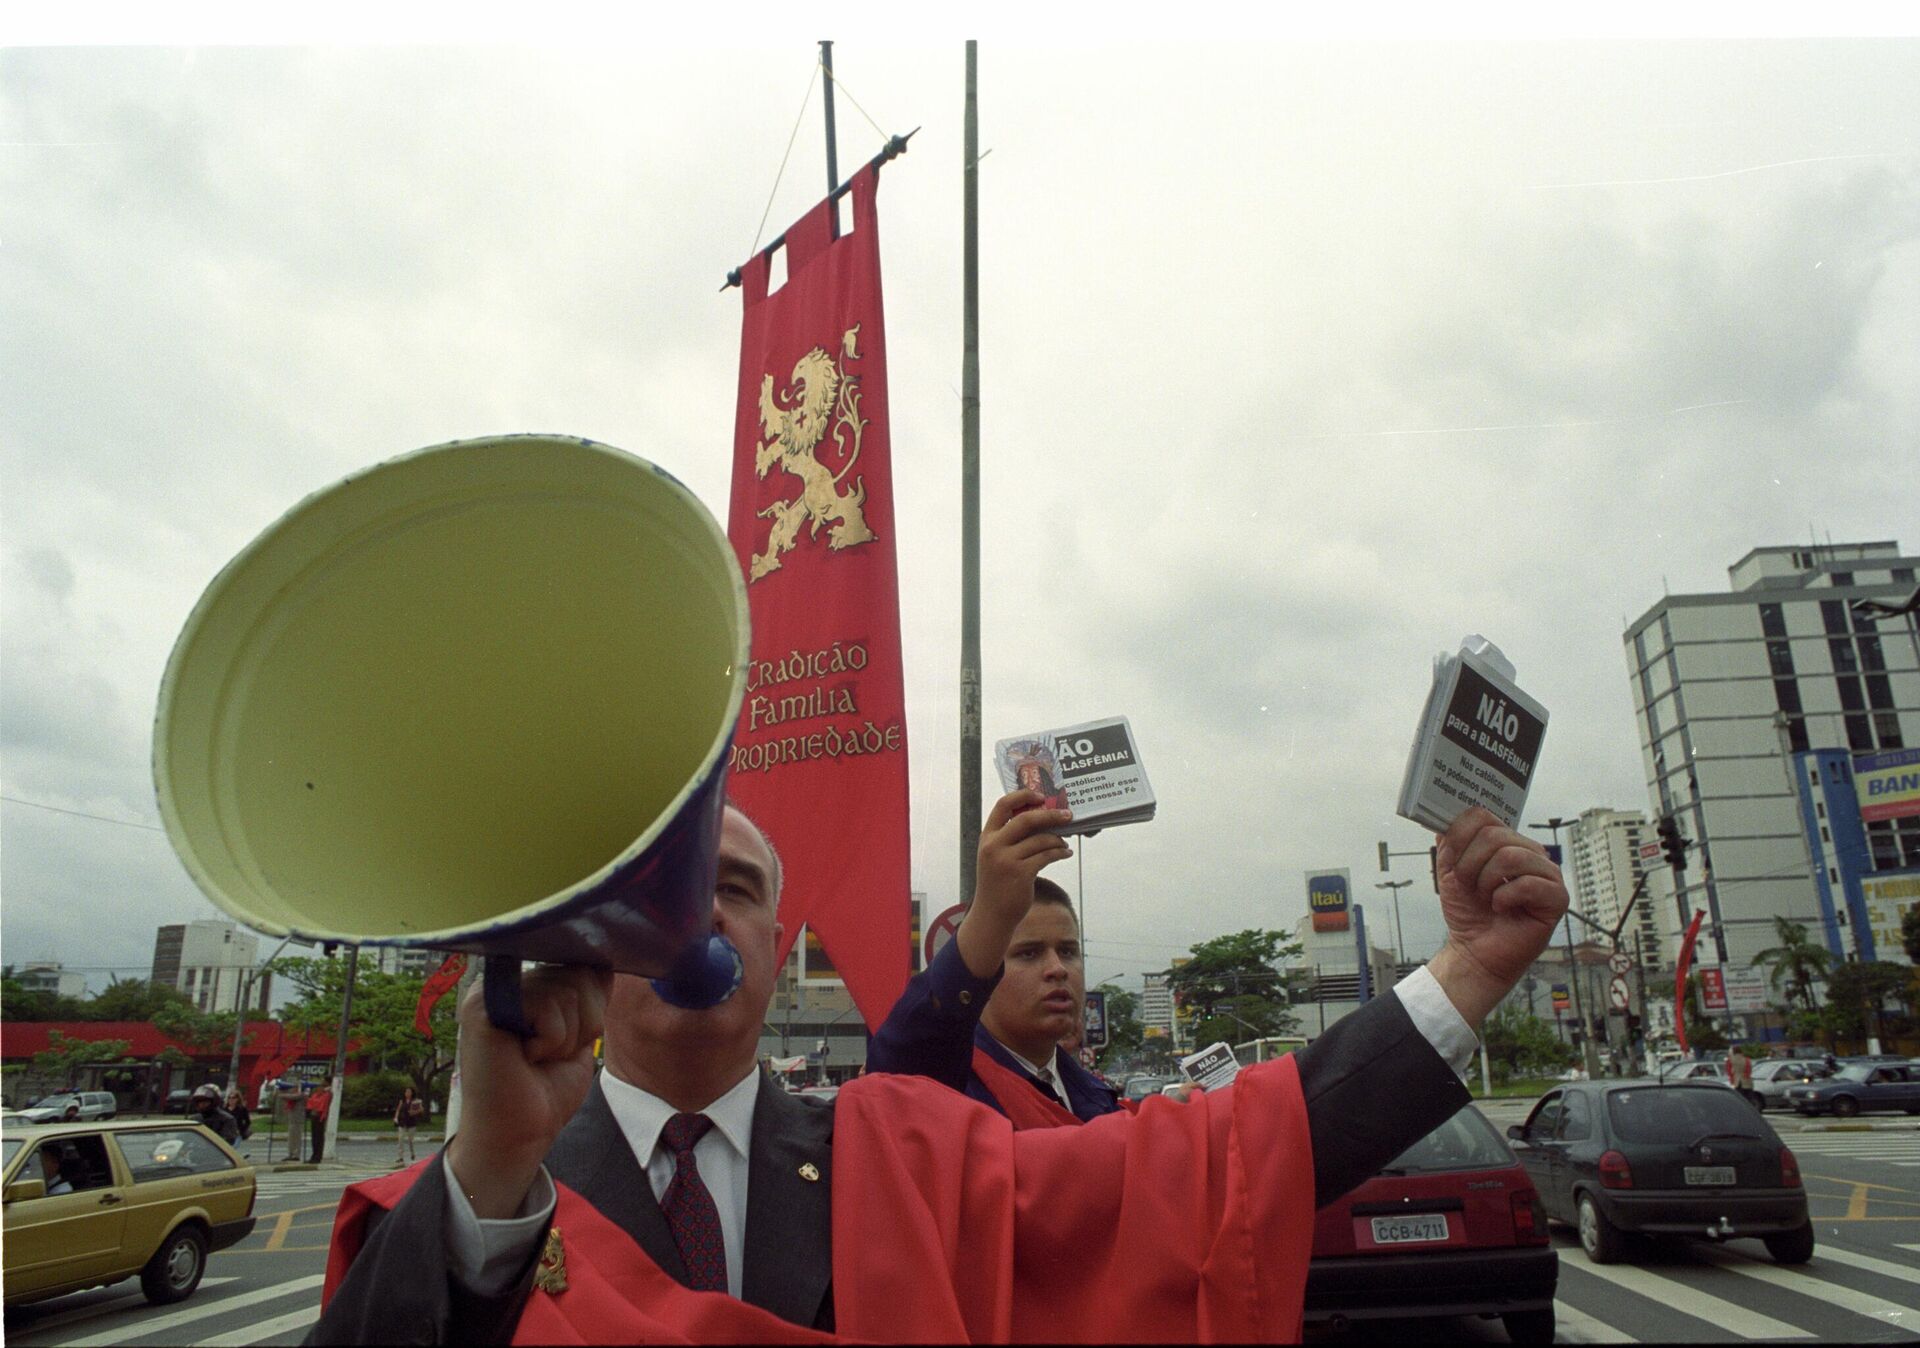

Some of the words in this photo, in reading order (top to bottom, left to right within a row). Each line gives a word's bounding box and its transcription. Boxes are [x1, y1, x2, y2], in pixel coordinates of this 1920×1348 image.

[1446, 713, 1471, 736] para
[1470, 729, 1479, 741] a
[1476, 692, 1519, 743] NÃO
[1060, 750, 1129, 772] LASFÊMIA!
[1065, 775, 1106, 789] católicos
[1079, 781, 1115, 797] permitir
[1118, 777, 1139, 787] esse
[1096, 790, 1123, 801] nossa
[1124, 786, 1136, 795] Fé
[1311, 889, 1344, 907] Itaú
[1197, 1054, 1218, 1071] NÃO
